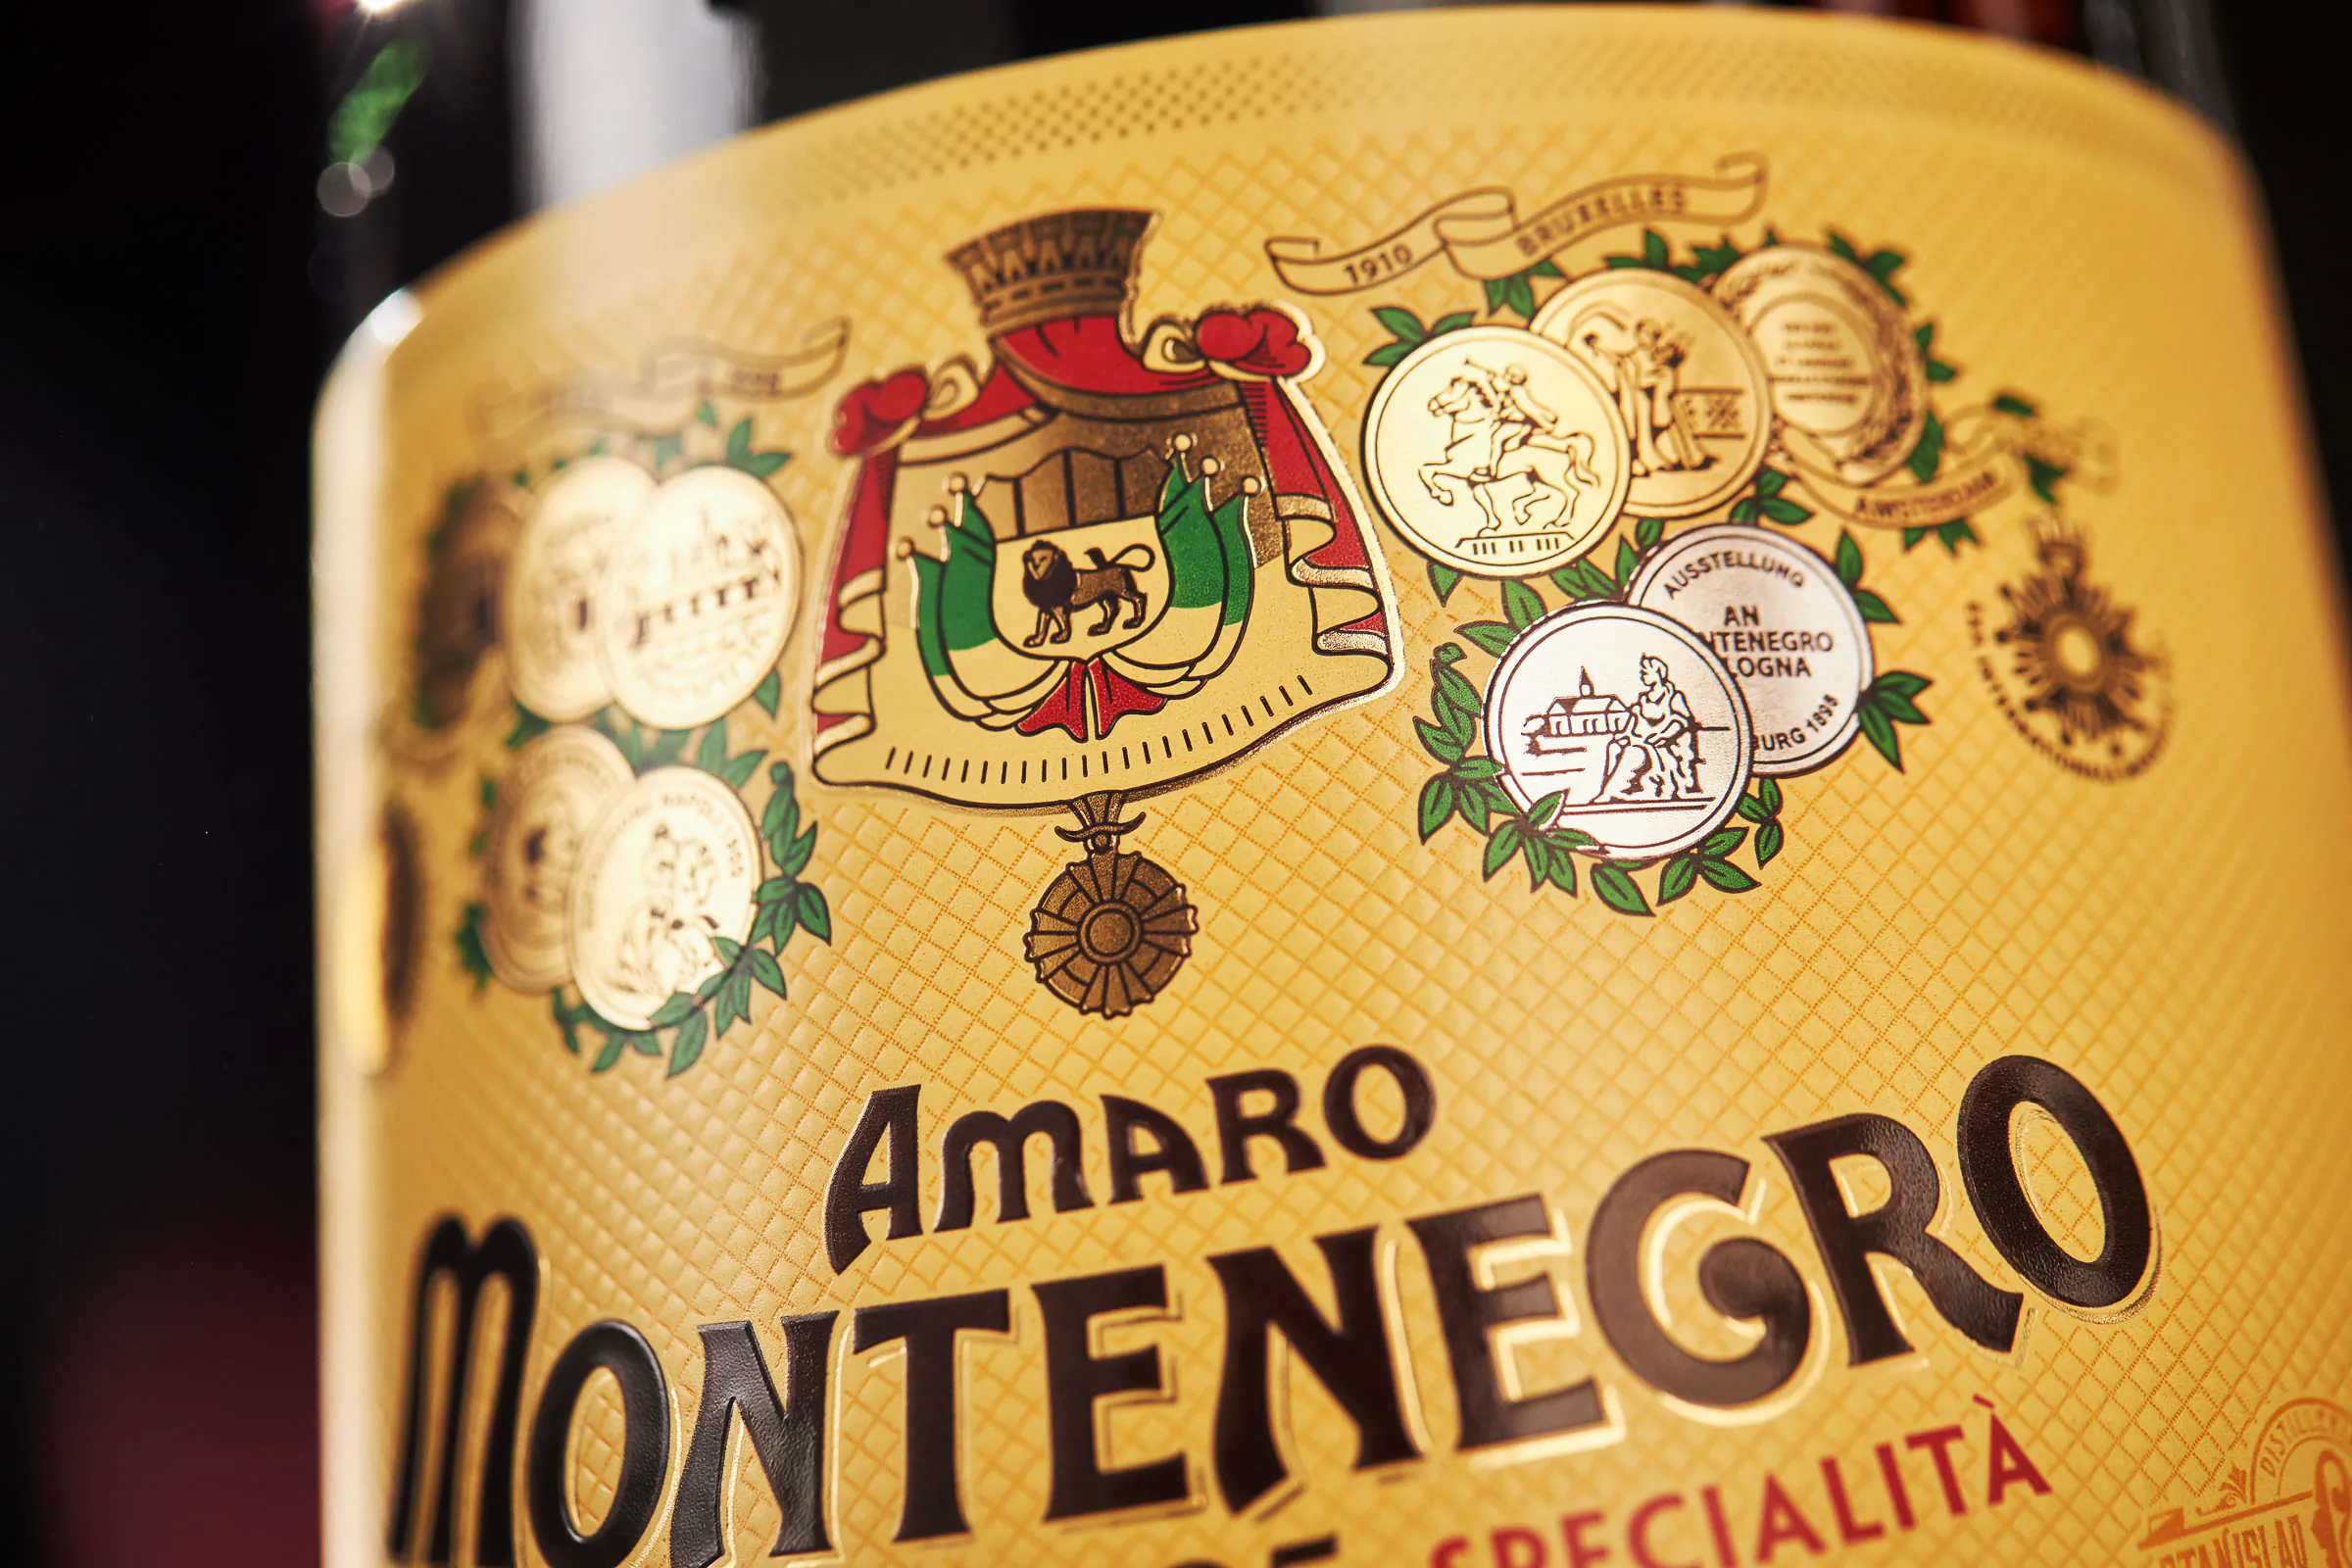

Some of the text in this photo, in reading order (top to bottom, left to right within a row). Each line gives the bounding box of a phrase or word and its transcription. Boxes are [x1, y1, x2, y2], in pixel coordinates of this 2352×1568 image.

[1344, 180, 1688, 286] 1910 BRUXELLES
[1723, 605, 1760, 627] AN
[823, 1044, 1438, 1276] AMARO
[385, 1054, 2154, 1568] MONTENEGRO
